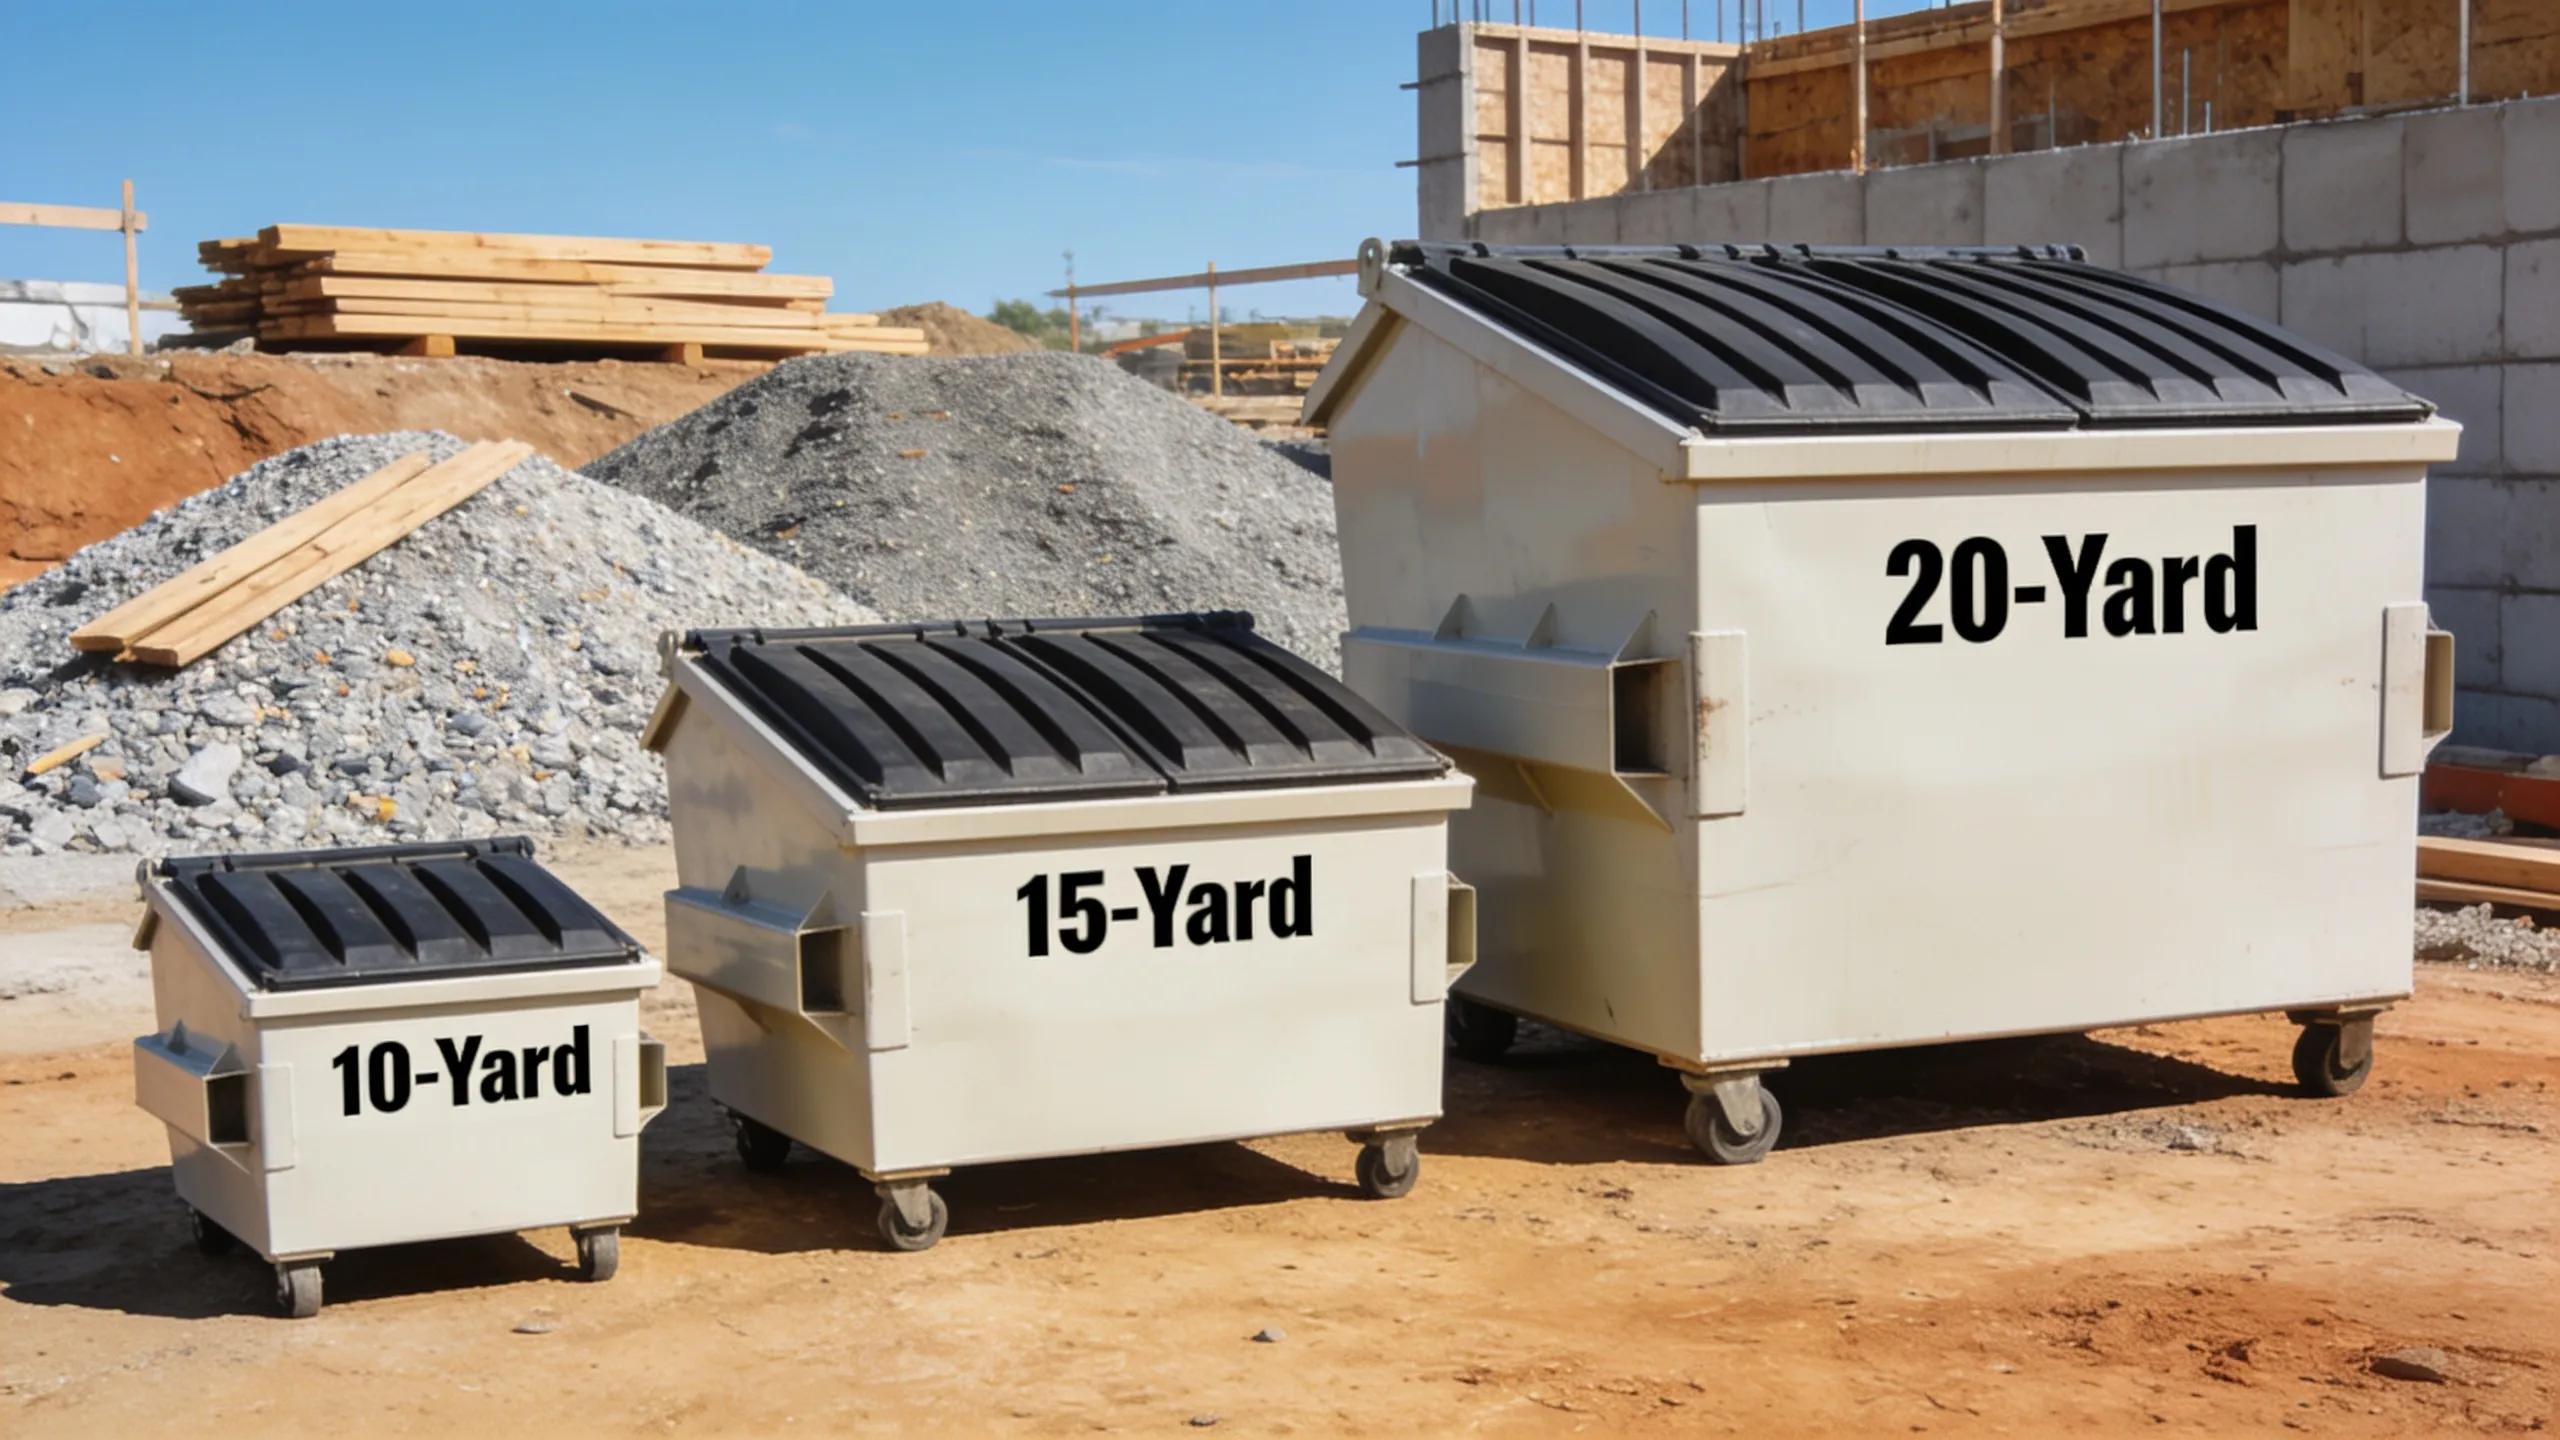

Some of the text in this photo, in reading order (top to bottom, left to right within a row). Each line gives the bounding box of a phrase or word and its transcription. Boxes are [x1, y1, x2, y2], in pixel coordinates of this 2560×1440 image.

[1885, 524, 2258, 646] 20-Yard
[1017, 854, 1313, 958] 15-Yard
[332, 1024, 591, 1117] 10-Yard
